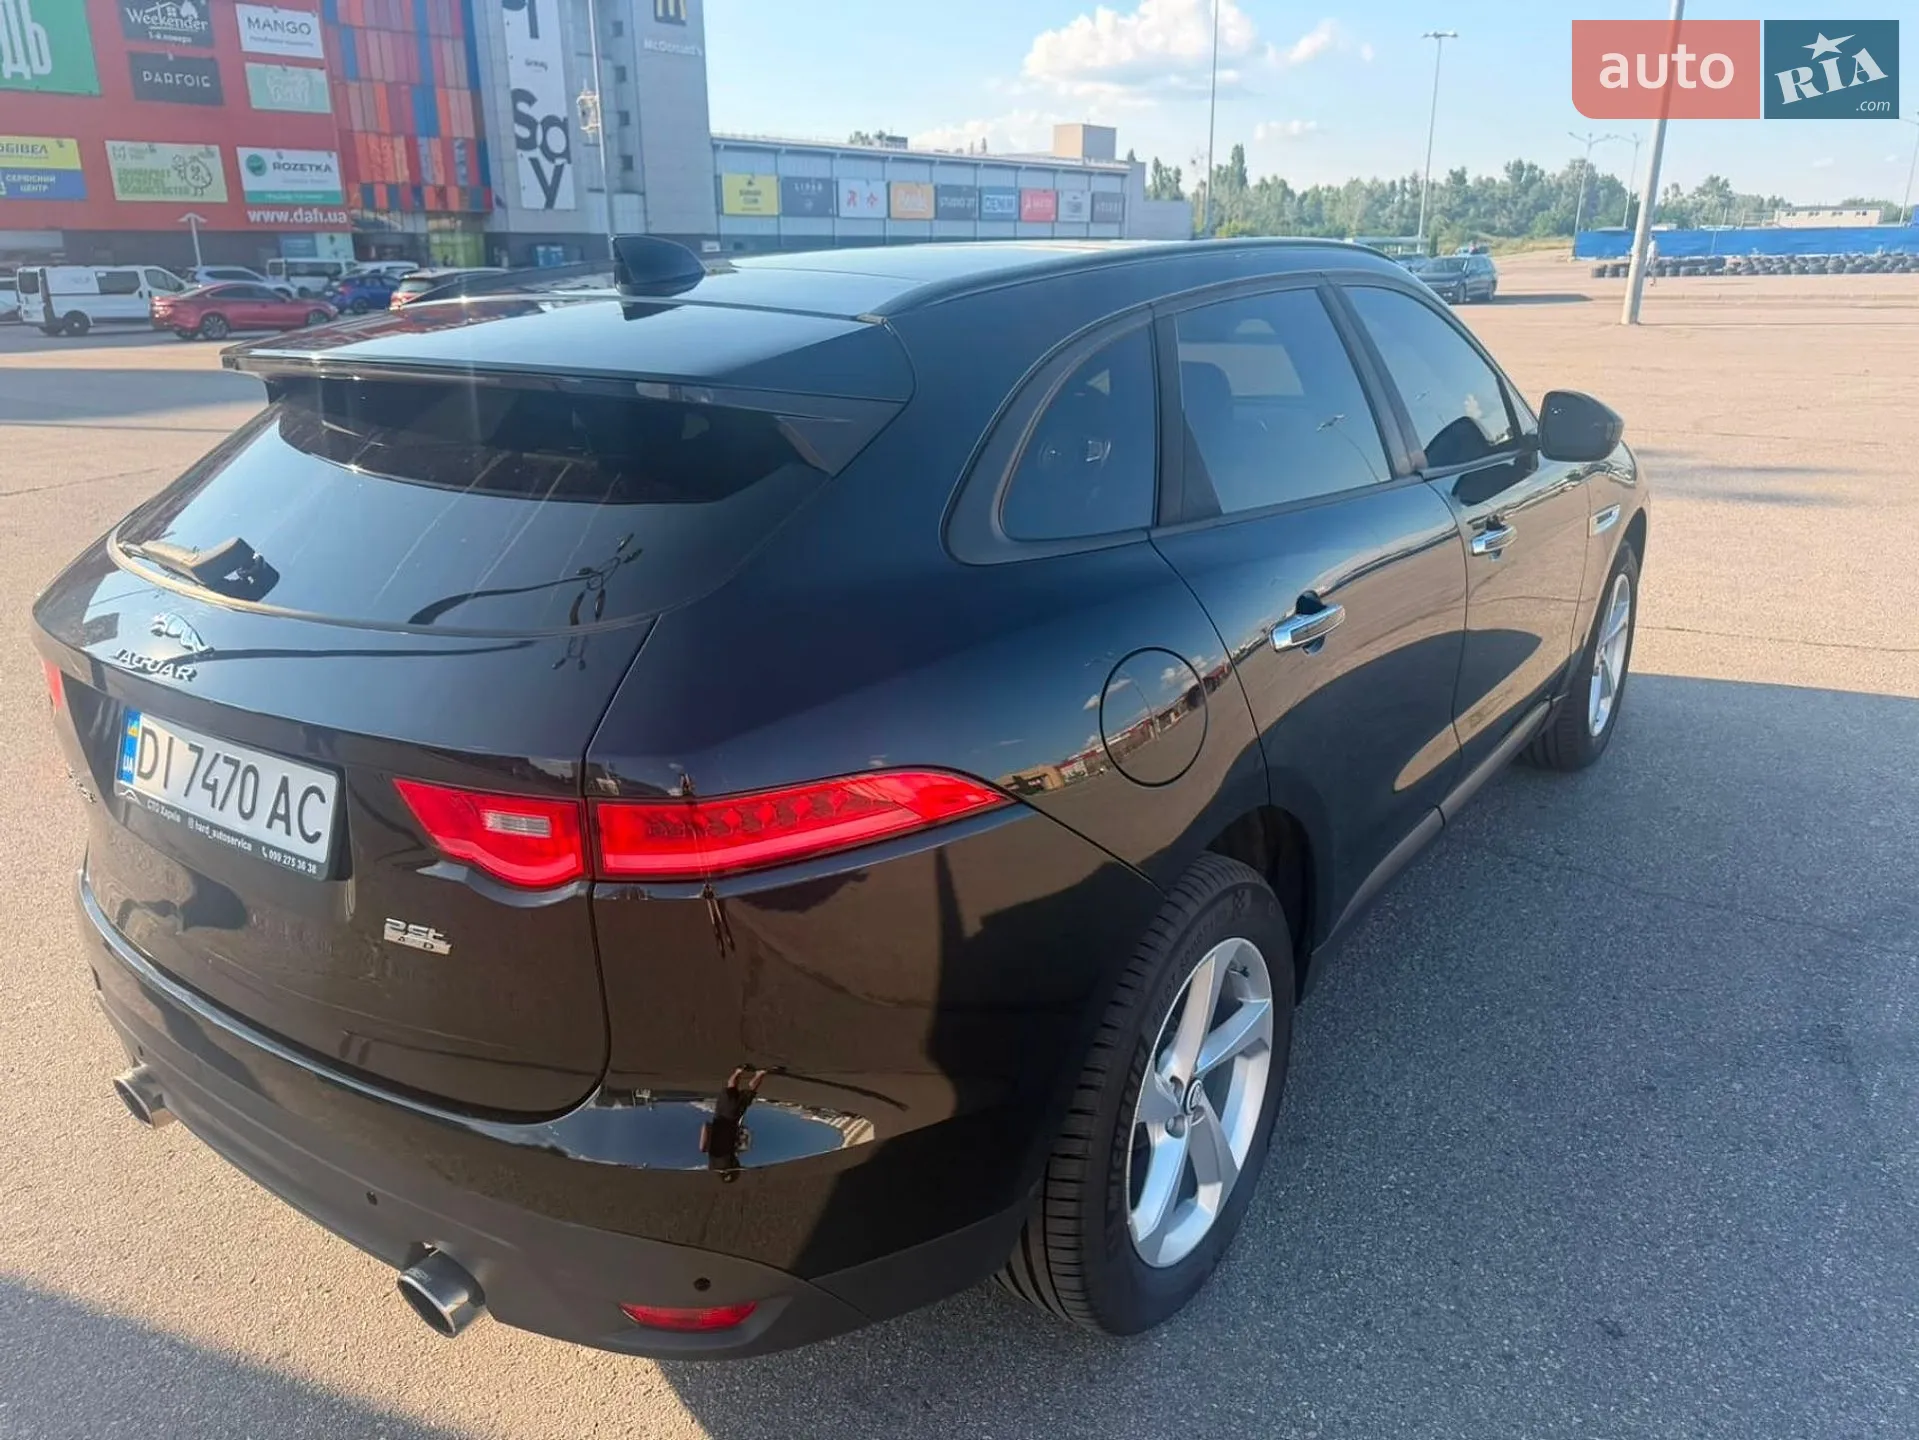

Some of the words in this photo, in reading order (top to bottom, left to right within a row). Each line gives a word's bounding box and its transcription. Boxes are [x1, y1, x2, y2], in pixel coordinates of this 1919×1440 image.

[124, 3, 208, 31] Weekender
[247, 16, 312, 35] MANGO
[272, 162, 334, 174] ROZETKA
[115, 649, 198, 682] JAGUAR
[137, 726, 174, 789] DI
[183, 743, 260, 821] 7470
[265, 775, 326, 844] AC
